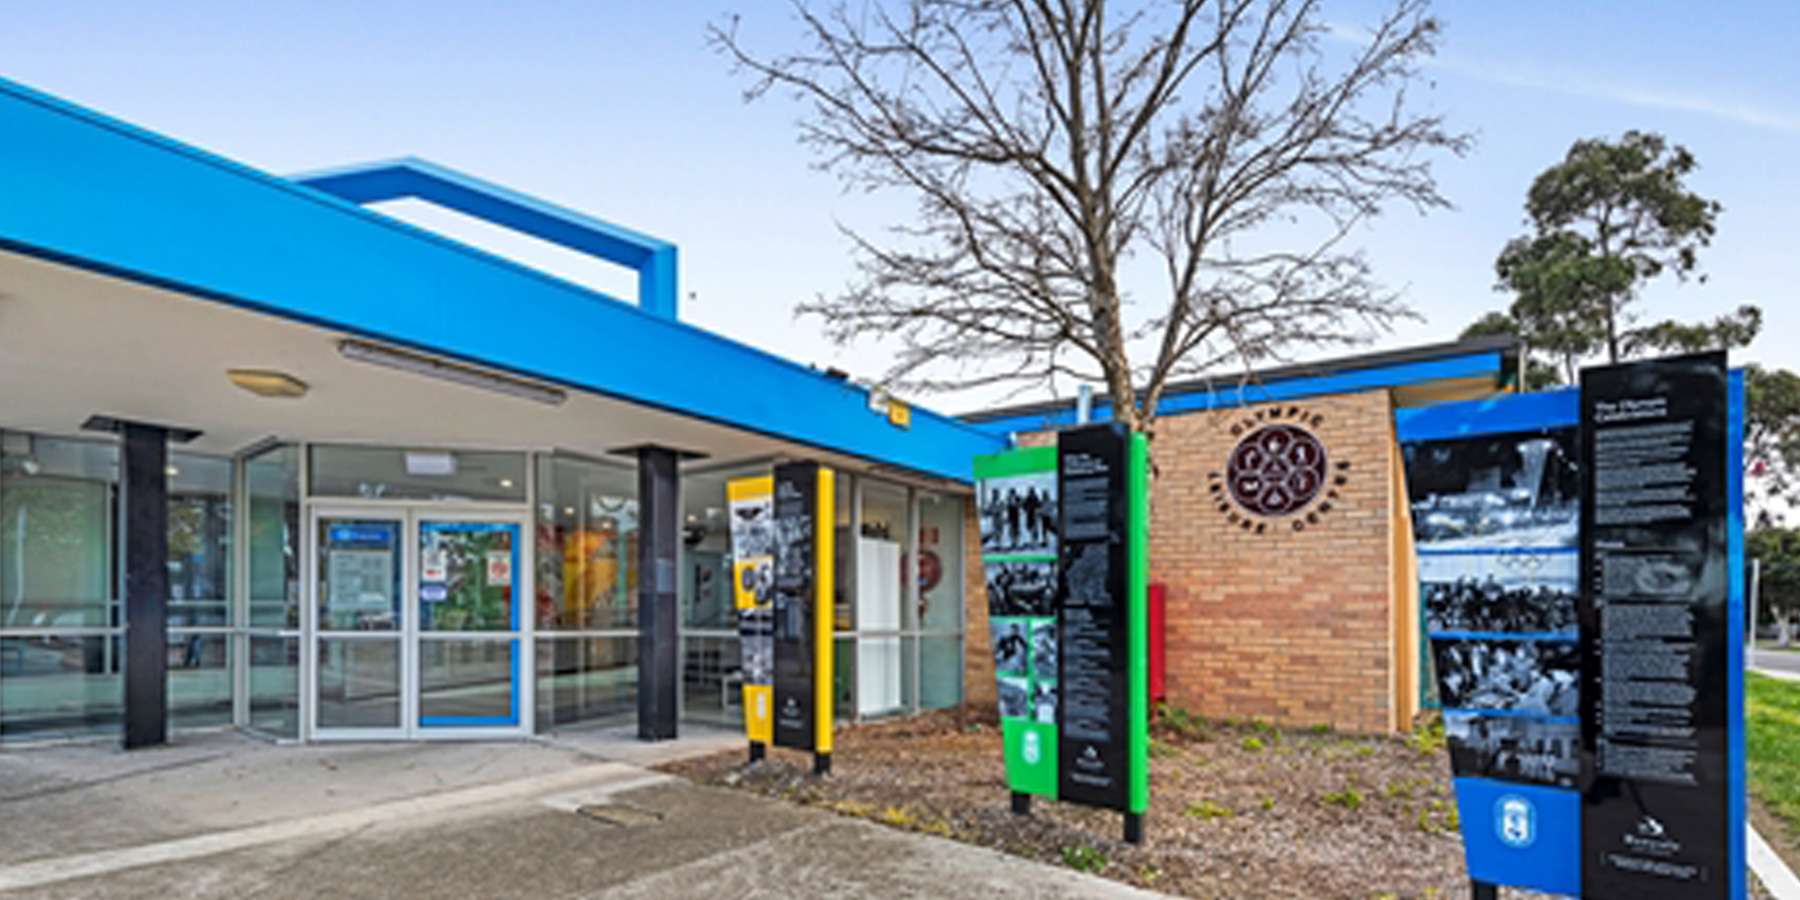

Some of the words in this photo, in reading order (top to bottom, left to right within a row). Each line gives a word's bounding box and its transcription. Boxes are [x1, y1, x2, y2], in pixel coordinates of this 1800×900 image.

[1230, 406, 1324, 437] OLYMPIC
[1207, 471, 1267, 534] LEISURE
[1291, 461, 1351, 532] CENTRE
